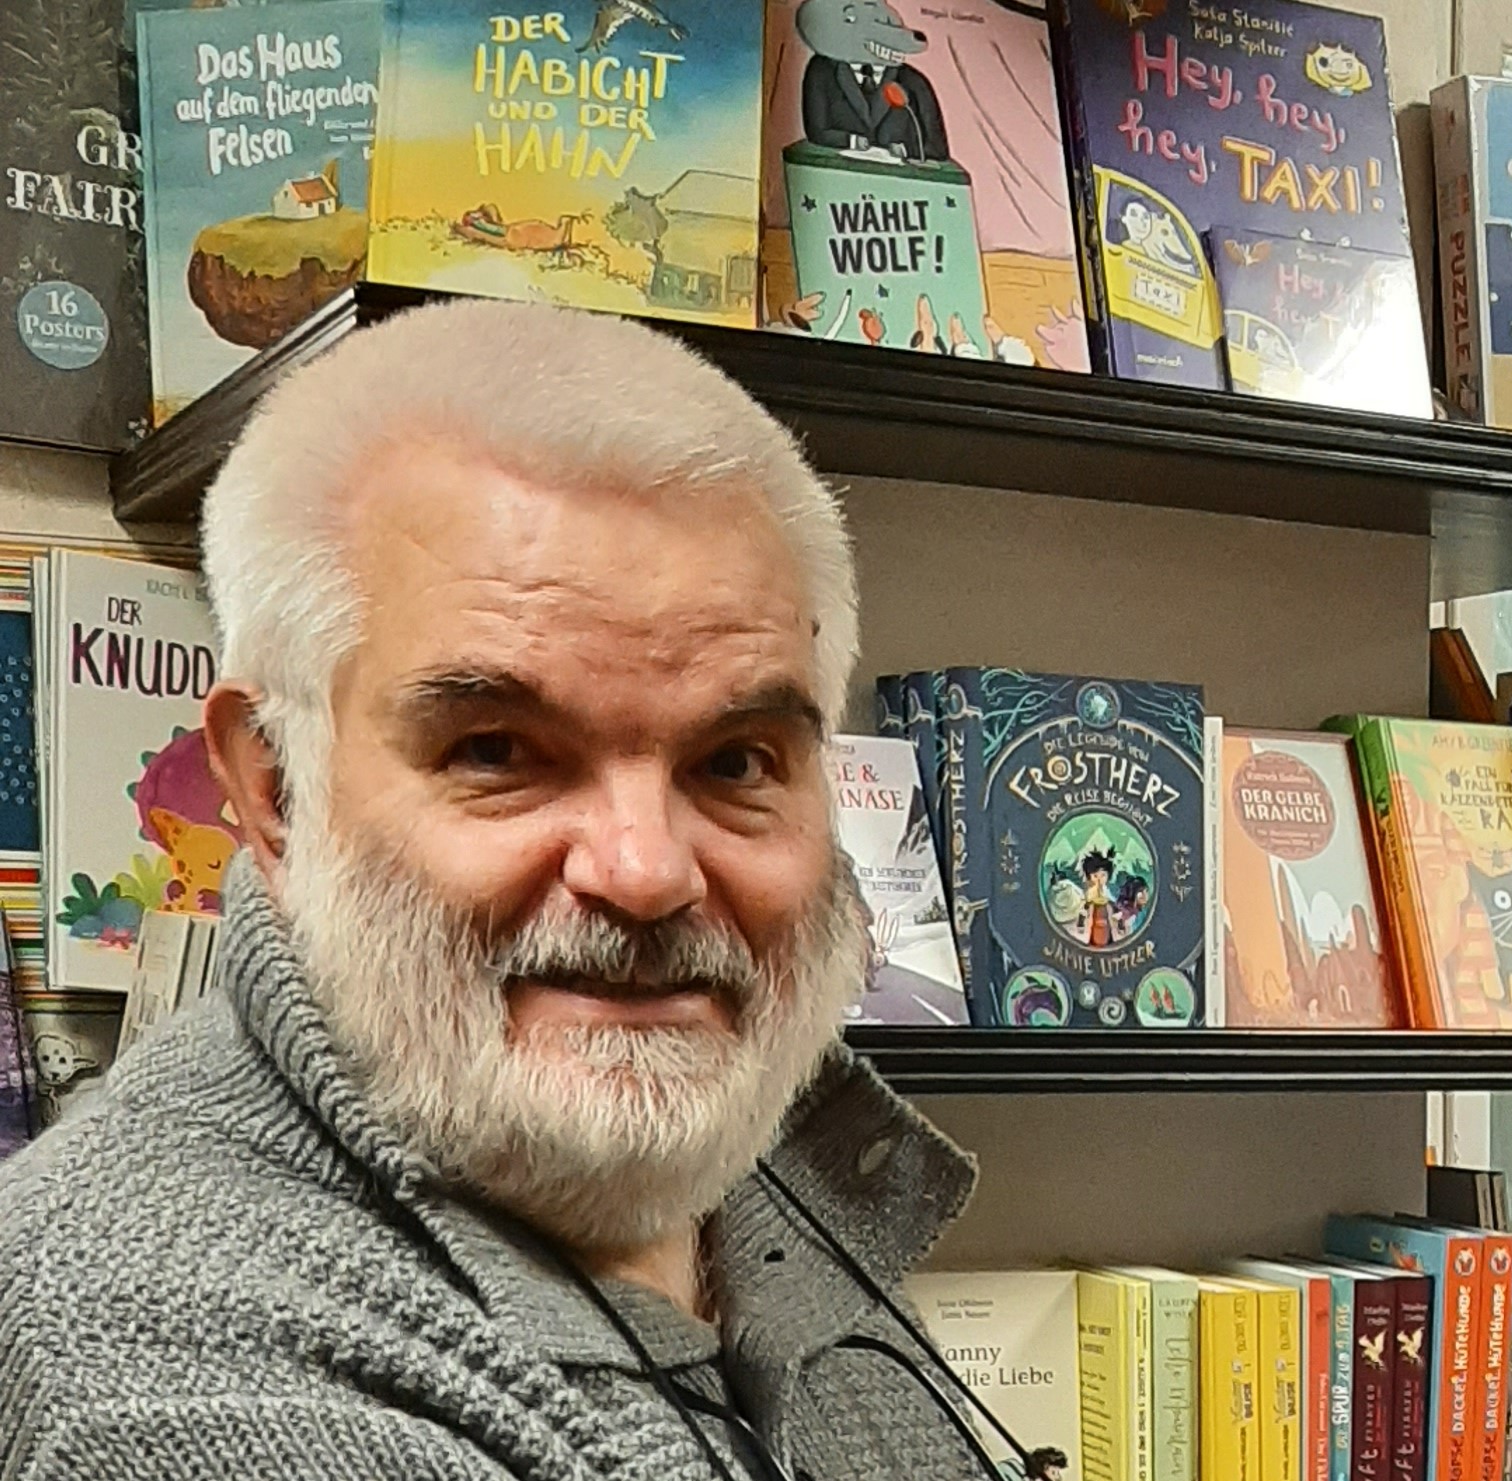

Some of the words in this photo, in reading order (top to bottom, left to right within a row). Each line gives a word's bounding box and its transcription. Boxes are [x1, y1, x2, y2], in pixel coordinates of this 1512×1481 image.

[490, 13, 571, 43] DER
[197, 44, 254, 85] Das
[256, 32, 342, 81] Haus
[474, 43, 686, 108] HABICHT
[176, 88, 214, 122] auf
[216, 87, 259, 119] dem
[266, 76, 378, 126] fliegenden
[488, 100, 557, 120] UND
[580, 105, 656, 141] DER
[209, 125, 293, 175] Felsen
[474, 122, 641, 179] HAHN
[1222, 134, 1385, 215] TAXI!
[829, 193, 930, 234] WÄHLT
[46, 290, 78, 316] 16
[1449, 230, 1472, 366] PUZZLE
[25, 314, 105, 341] Posters
[107, 596, 143, 626] DER
[1010, 752, 1181, 818] FROSTHERZ
[1241, 788, 1273, 804] DER
[1275, 790, 1321, 807] GELBE
[950, 729, 967, 887] FROSTHERZ
[1243, 803, 1328, 824] KRANICH
[940, 1344, 1002, 1366] anny
[999, 1367, 1054, 1386] Liebe
[1332, 1385, 1350, 1427] SPUR
